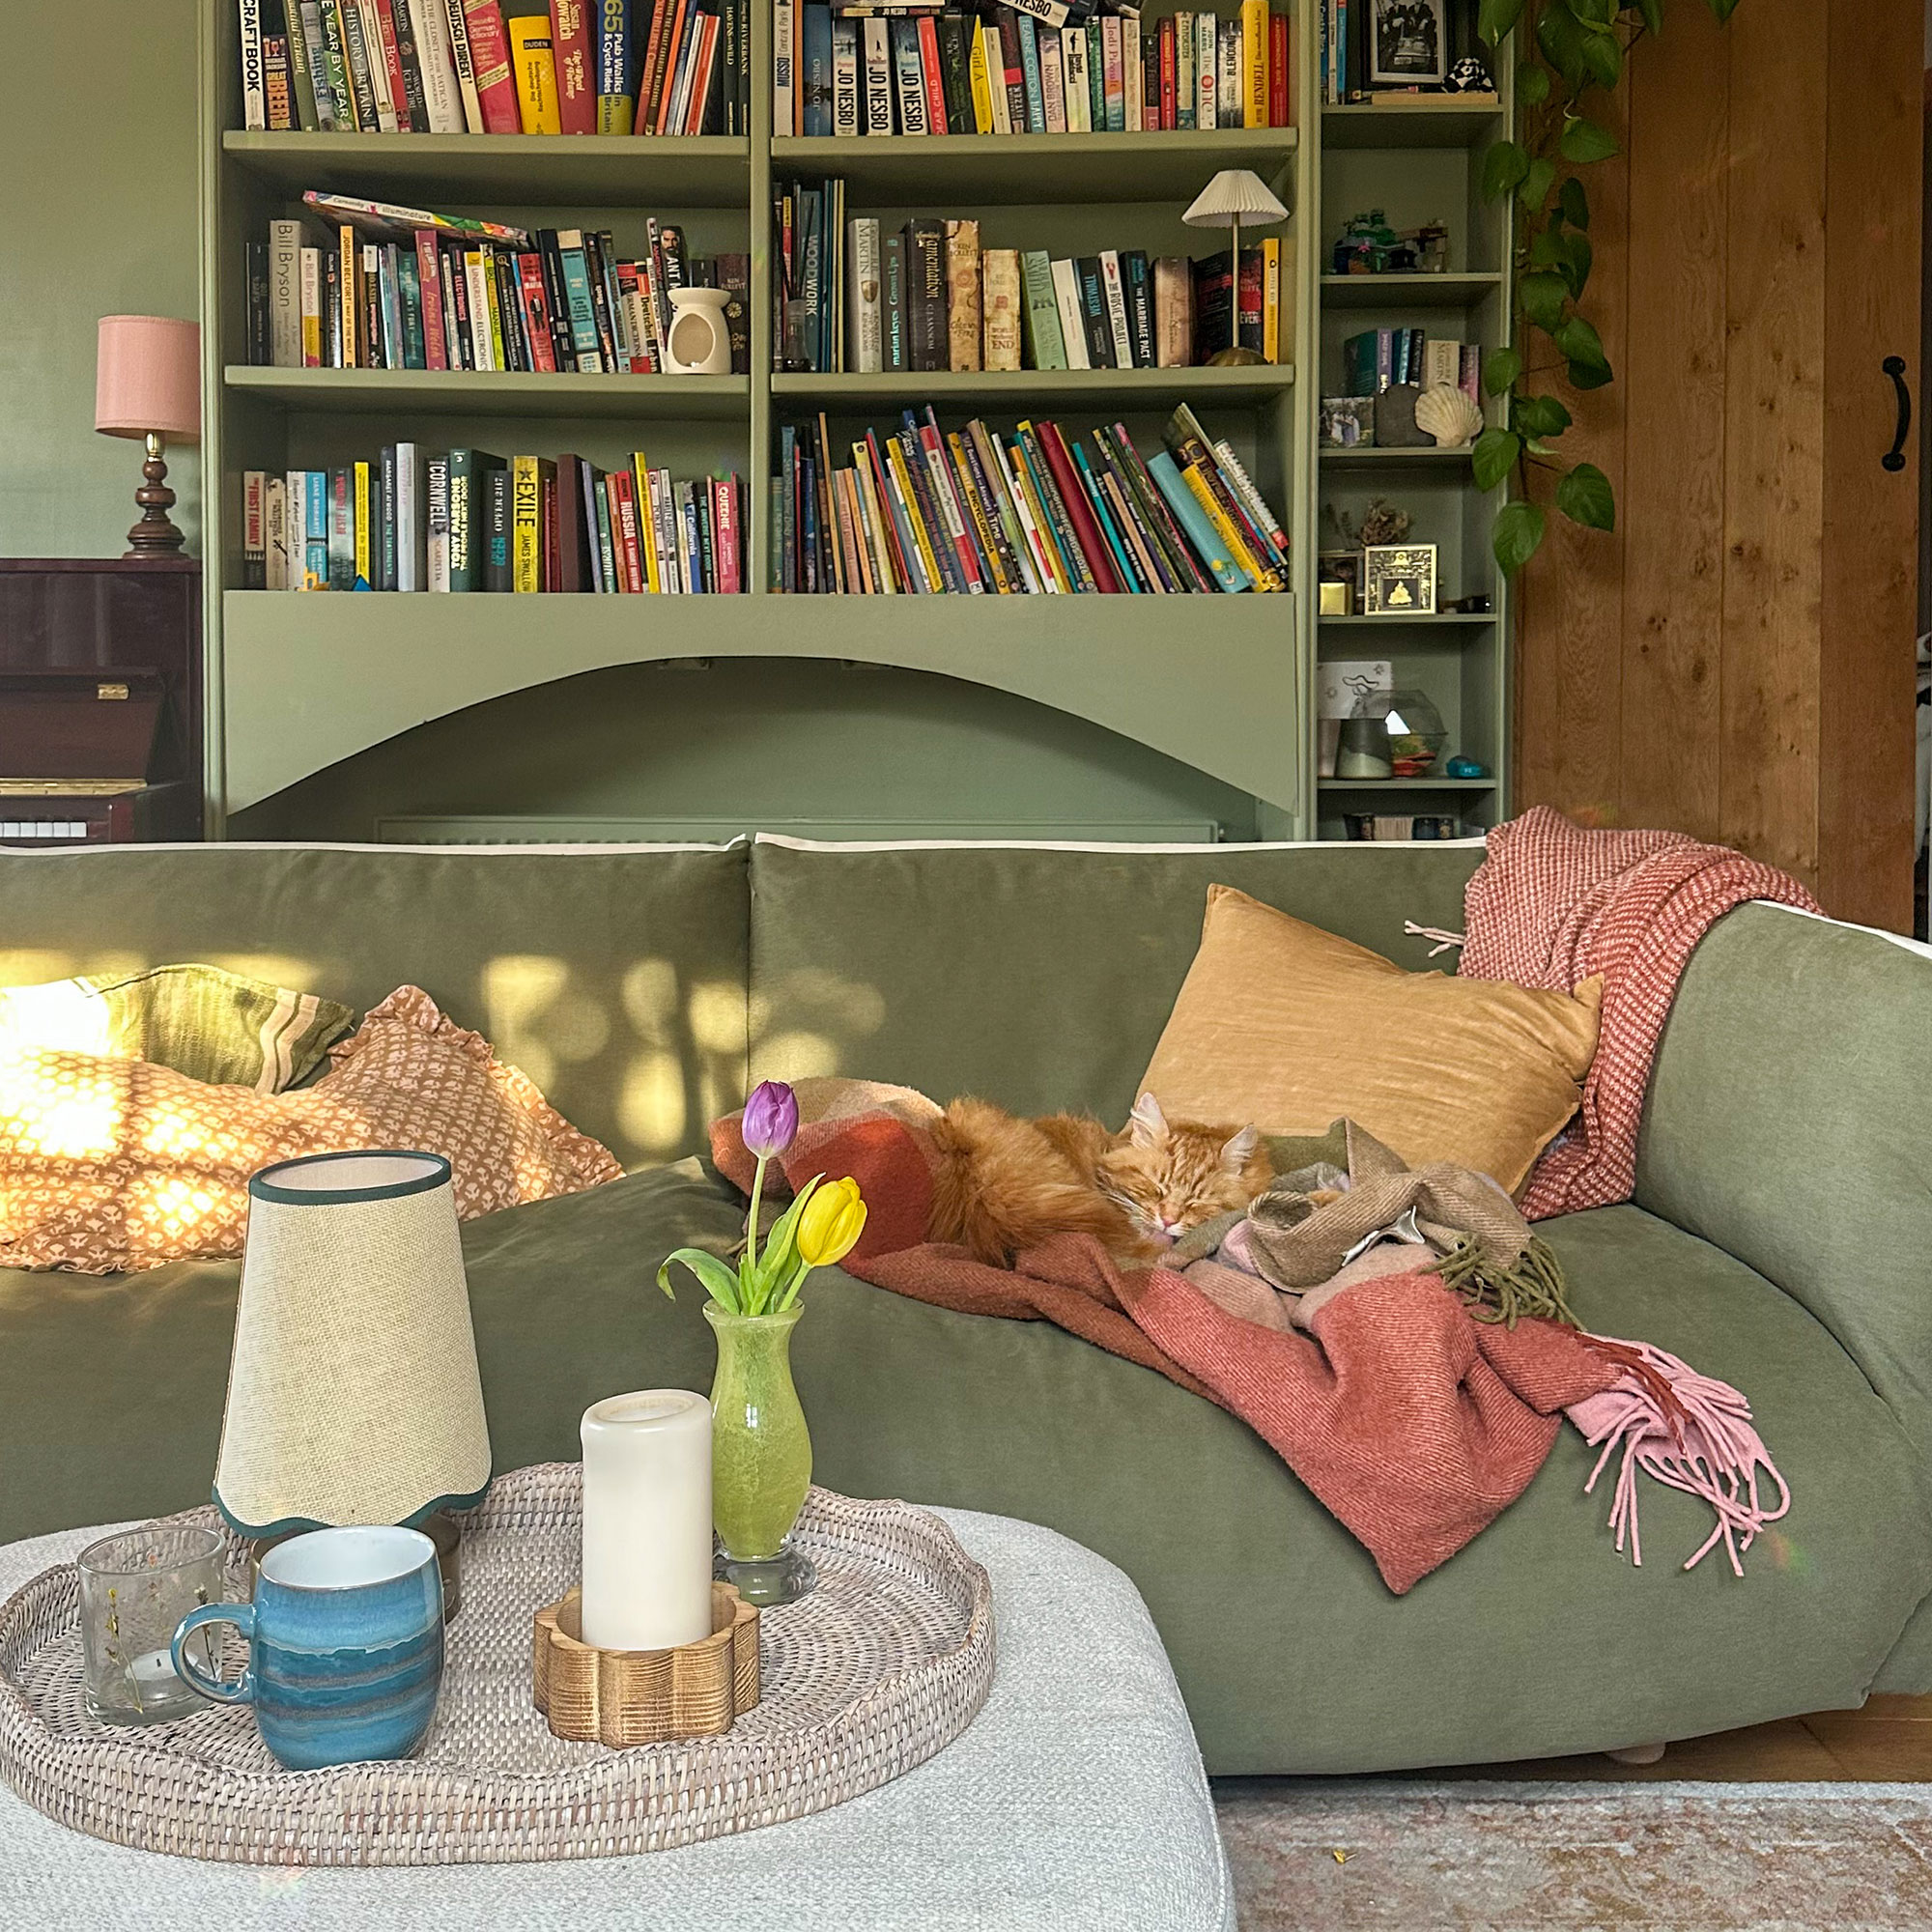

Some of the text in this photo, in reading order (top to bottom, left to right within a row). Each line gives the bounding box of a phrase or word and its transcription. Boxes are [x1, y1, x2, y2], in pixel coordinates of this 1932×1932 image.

[324, 13, 339, 52] YEAR
[397, 0, 409, 32] MARTIN
[448, 0, 464, 43] DEUTSCH
[569, 4, 581, 30] Susan
[726, 7, 737, 66] HAVENS WILD
[242, 0, 261, 92] CRAFT BOOK
[329, 54, 344, 76] BY
[346, 9, 372, 118] HISTORY BRITAIN
[386, 44, 398, 76] BOOK
[430, 21, 450, 109] CLOSET VATICAN
[602, 42, 613, 68] Cycle
[613, 33, 624, 94] Pub Walks
[740, 23, 749, 76] RIVERBANK
[971, 45, 983, 69] Girl
[1105, 24, 1120, 87] Jodi Picoult
[1226, 35, 1236, 76] BLENDUNG
[575, 66, 585, 93] Wheel
[604, 68, 613, 94] Rides
[639, 51, 659, 96] CHRISTMAS
[777, 57, 790, 88] MUSSO
[811, 58, 821, 94] NESBO
[930, 79, 940, 108] CHILD
[974, 72, 983, 83] A
[1021, 19, 1042, 128] FEARNE COTTON HAPPY
[1044, 64, 1058, 123] DAN BROWN
[1201, 74, 1214, 113] One
[1253, 64, 1264, 106] RENDELL
[268, 80, 289, 119] BEER
[334, 78, 350, 119] YEAR
[604, 96, 615, 133] Britain
[613, 95, 622, 107] in
[838, 69, 854, 127] JO NESBO
[868, 67, 889, 130] JO NESBO
[900, 69, 924, 132] JO NESBO
[1014, 86, 1025, 119] FITZEK
[276, 224, 294, 308] Bill Bryson
[339, 235, 354, 301] JORDAN BELFORT
[858, 223, 869, 274] MARTIN
[304, 263, 316, 314] Bill Bryson
[454, 274, 468, 322] ELECTRONICS
[805, 235, 818, 317] WOODWORK
[1084, 273, 1102, 317] WESTWALL
[408, 313, 416, 330] FURY
[425, 291, 442, 358] Irvine Welsh
[470, 267, 489, 372] UNDERSTAND ELECTRONICS
[491, 306, 501, 336] MANUAL
[640, 296, 658, 373] Deutsches Leben
[889, 309, 901, 366] marian keyes
[1109, 292, 1127, 345] ROSIE PROJECT
[1135, 287, 1151, 359] THE MARRIAGE PACT
[992, 339, 1014, 351] END
[247, 485, 260, 513] FIRST
[698, 496, 707, 508] THE
[967, 448, 993, 512] Questions Answers
[312, 498, 322, 535] MORIARTY
[428, 466, 446, 582] CORNWELL SCARPETTA
[450, 476, 462, 570] TONY PARSONS
[494, 476, 503, 531] OPFER 2117
[619, 500, 637, 540] RUSSIA
[718, 486, 730, 530] QUEENIE
[969, 489, 995, 554] ENCYCLOPEDIA
[247, 513, 261, 546] FAMILY
[516, 482, 536, 592] EXILE JAMES SWALLOW
[685, 516, 697, 556] California
[702, 537, 711, 554] NEXT
[839, 502, 856, 562] artful parent
[989, 517, 1002, 540] Time
